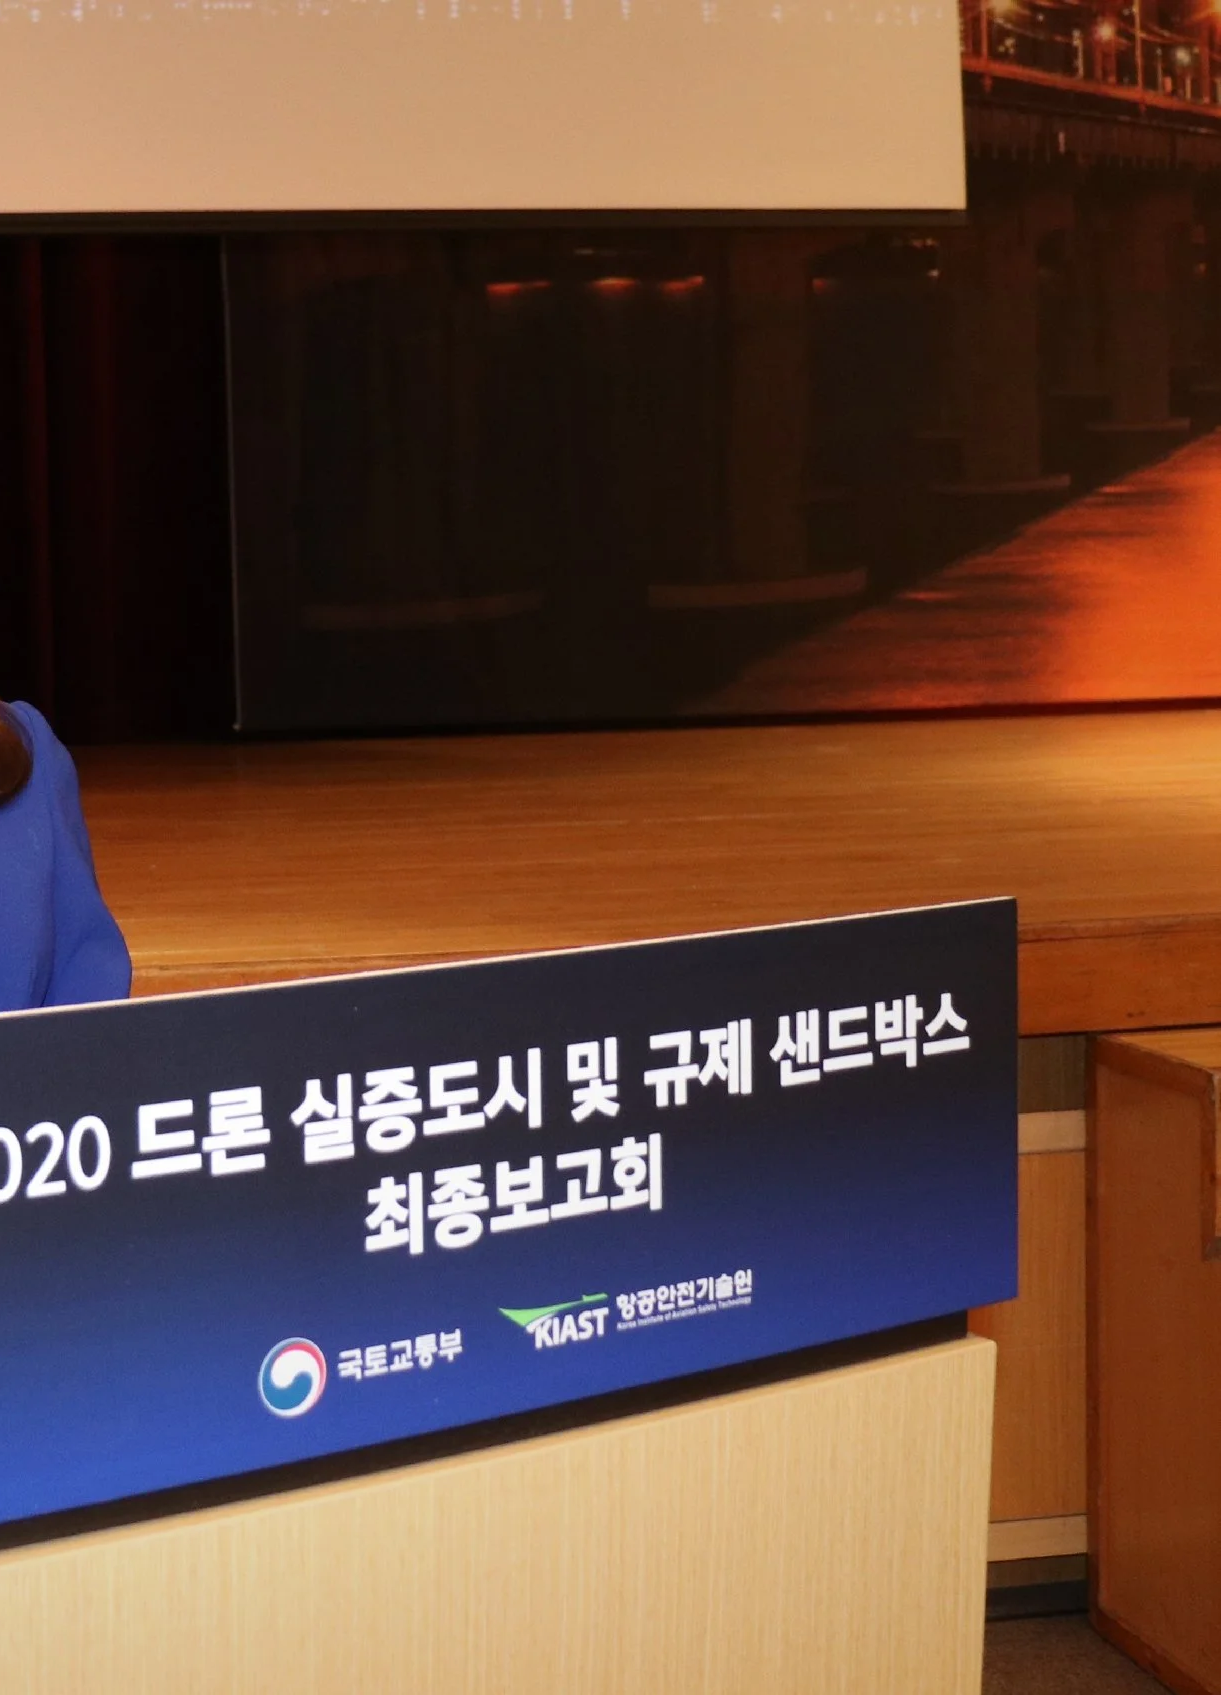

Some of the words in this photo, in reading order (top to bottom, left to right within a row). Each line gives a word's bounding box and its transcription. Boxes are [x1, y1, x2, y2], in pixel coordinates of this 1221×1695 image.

[131, 1086, 271, 1180] 드론
[290, 1047, 544, 1164] 실증도시
[565, 1037, 620, 1123] 및
[643, 1018, 753, 1108] 규제
[769, 992, 970, 1087] 샌드박스
[365, 1132, 663, 1255] 최종보고회
[616, 1268, 753, 1321] 항공안전기술원
[337, 1328, 464, 1381] 국토교통부
[533, 1307, 609, 1349] KIAST
